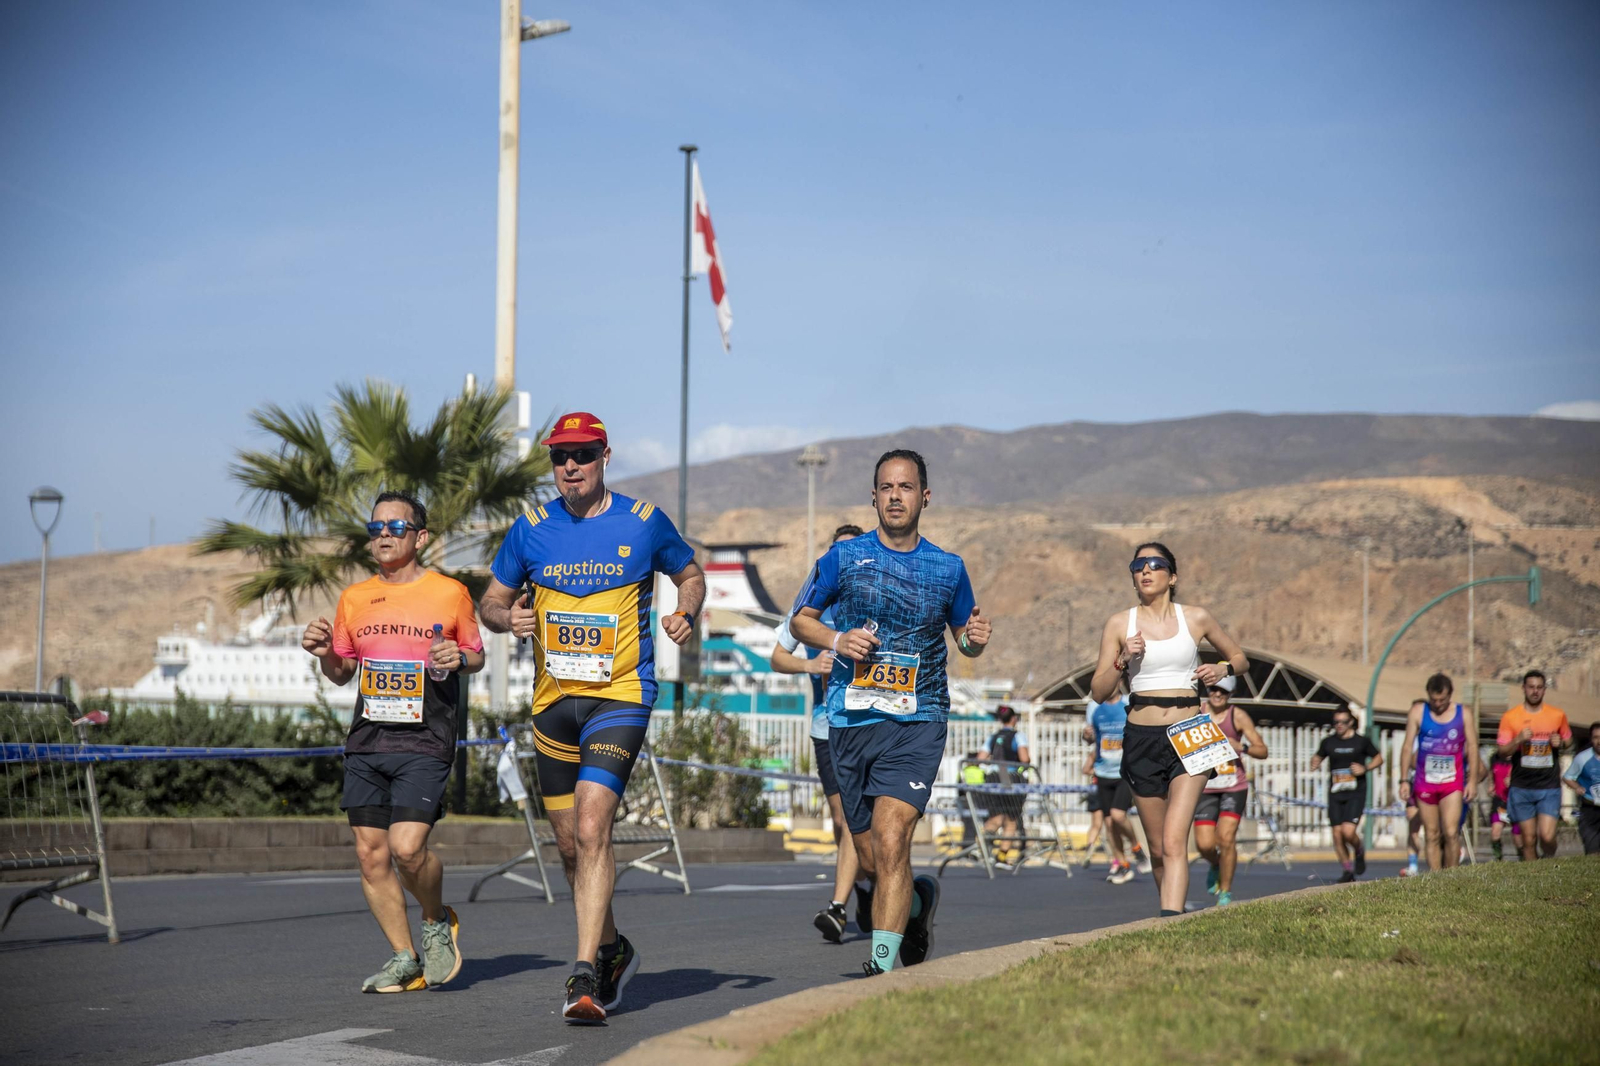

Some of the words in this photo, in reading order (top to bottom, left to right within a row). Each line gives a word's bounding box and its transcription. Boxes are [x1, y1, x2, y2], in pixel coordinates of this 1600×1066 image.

[543, 559, 624, 580] agustinos
[555, 578, 609, 586] GRANADA
[356, 624, 434, 639] COSENTINO
[558, 625, 602, 647] 899
[366, 671, 417, 691] 1855
[1178, 722, 1219, 749] 1861
[589, 742, 630, 759] agustinos
